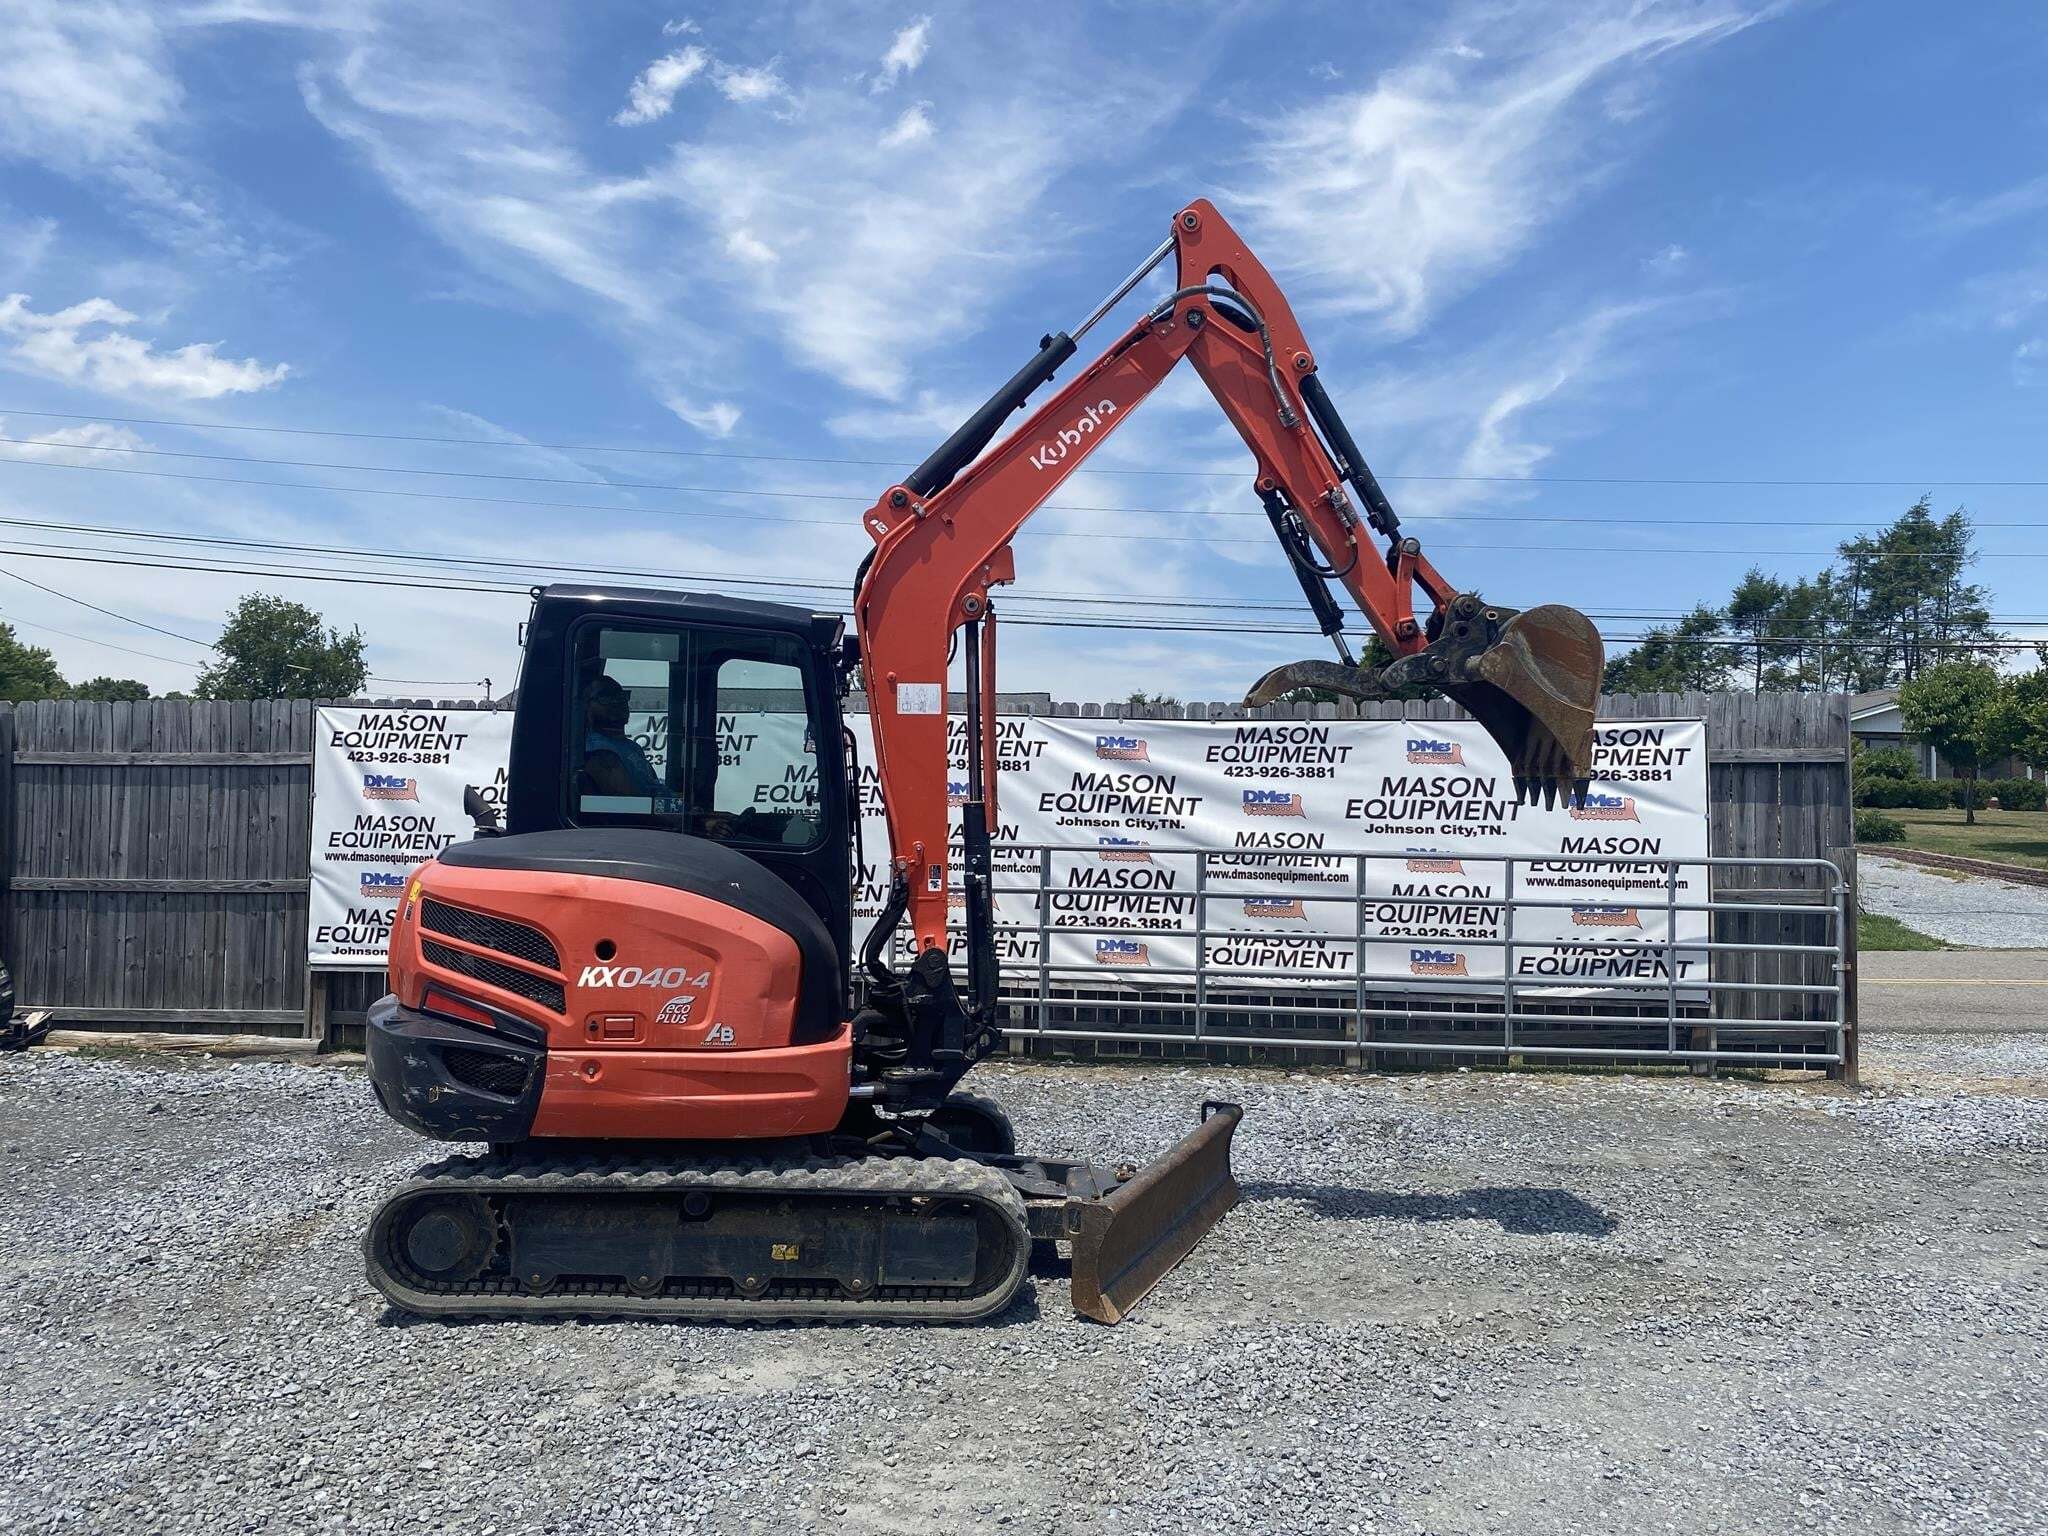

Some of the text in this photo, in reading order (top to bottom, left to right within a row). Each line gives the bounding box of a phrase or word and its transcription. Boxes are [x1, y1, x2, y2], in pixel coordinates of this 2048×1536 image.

[1029, 399, 1117, 471] Kubota
[358, 714, 447, 733] MASON
[330, 731, 468, 751] EQUIPMENT
[1234, 727, 1329, 745] MASON
[347, 751, 451, 765] 423-926-3881
[1206, 745, 1353, 764] EQUIPMENT
[1224, 766, 1336, 779] 423-926-3881
[1071, 772, 1176, 795] MASON
[1381, 776, 1496, 798] MASON
[1038, 792, 1203, 817] EQUIPMENT
[1345, 798, 1523, 822] EQUIPMENT
[354, 815, 436, 833] MASON
[1056, 816, 1186, 831] Johnson City,TN.
[1364, 823, 1507, 838] Johnson City,TN.
[328, 831, 456, 850] EQUIPMENT
[1234, 831, 1325, 850] MASON
[1560, 836, 1661, 855] MASON
[1067, 867, 1176, 890] MASON
[1205, 868, 1349, 884] www.dmasonequipment.com
[1391, 883, 1491, 899] MASON
[1055, 914, 1183, 930] 423-926-3881
[331, 946, 388, 956] Johnson
[577, 966, 711, 989] KX040-4
[666, 1003, 691, 1014] eco
[655, 1013, 688, 1024] PLUS
[705, 1022, 735, 1042] AB
